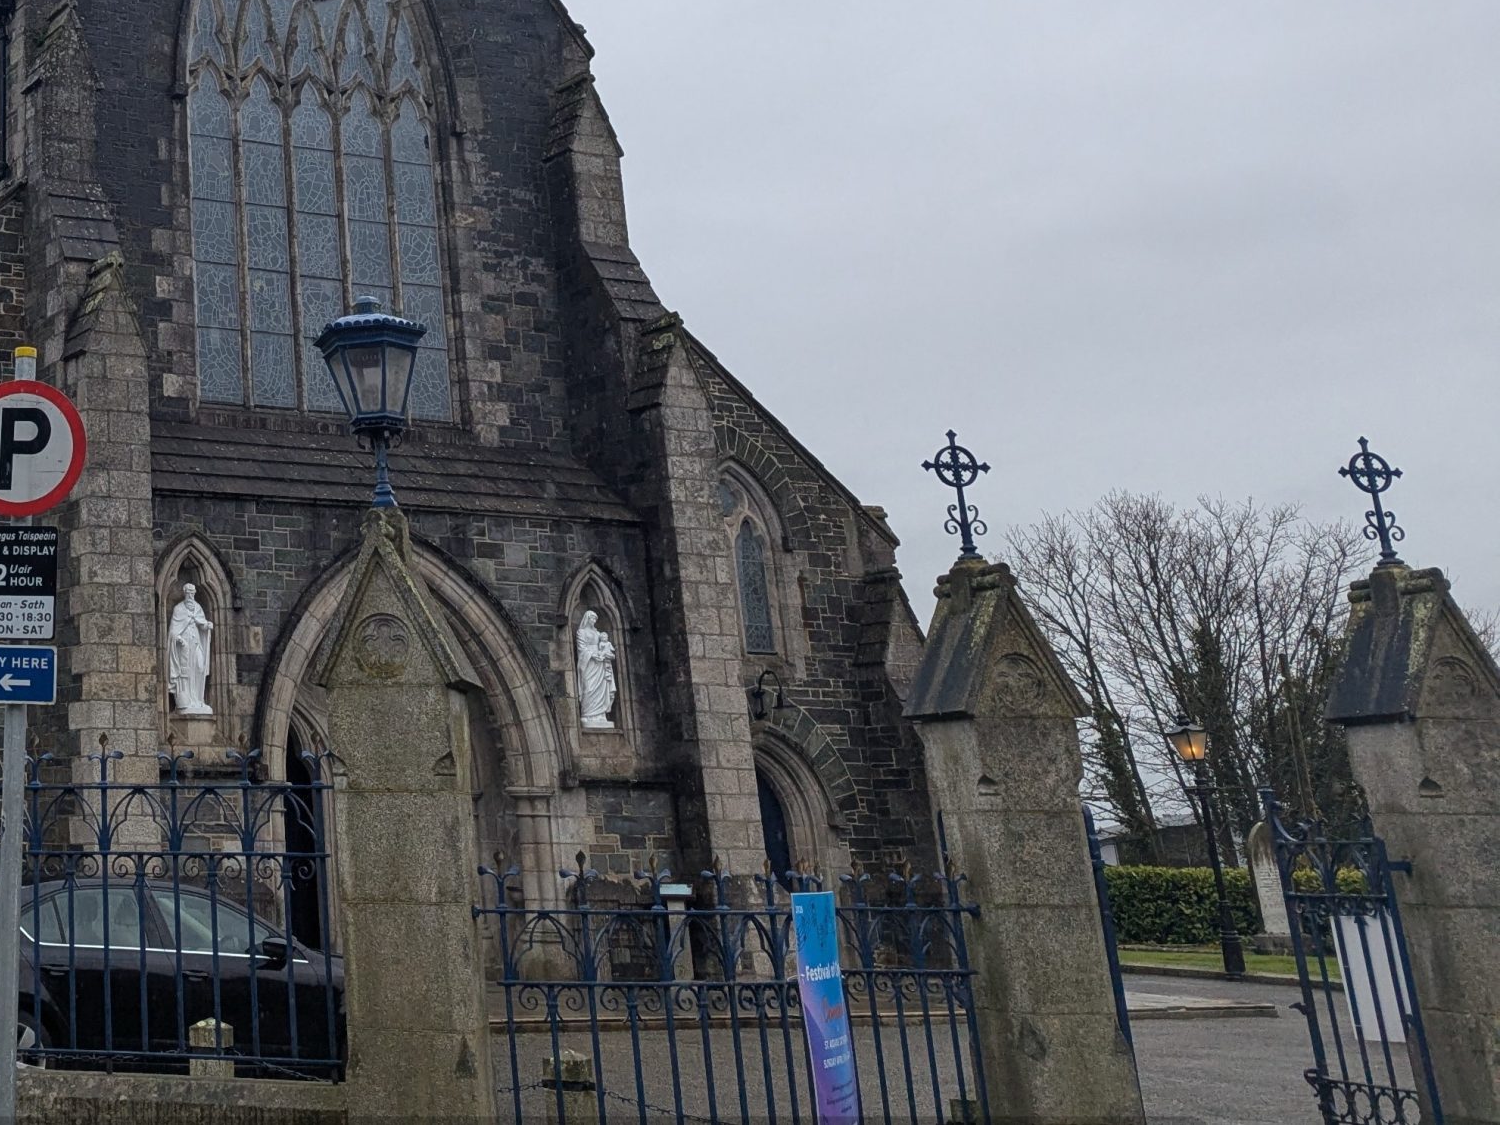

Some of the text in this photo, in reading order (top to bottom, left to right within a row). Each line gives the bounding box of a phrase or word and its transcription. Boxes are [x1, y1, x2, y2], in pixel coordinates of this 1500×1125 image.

[2, 546, 10, 556] &
[13, 546, 56, 556] DISPLAY
[9, 564, 33, 574] Uair
[10, 577, 43, 587] HOUR
[20, 600, 45, 610] Sath
[22, 612, 52, 622] 18:30
[22, 625, 45, 635] SAT
[11, 656, 49, 669] HERE
